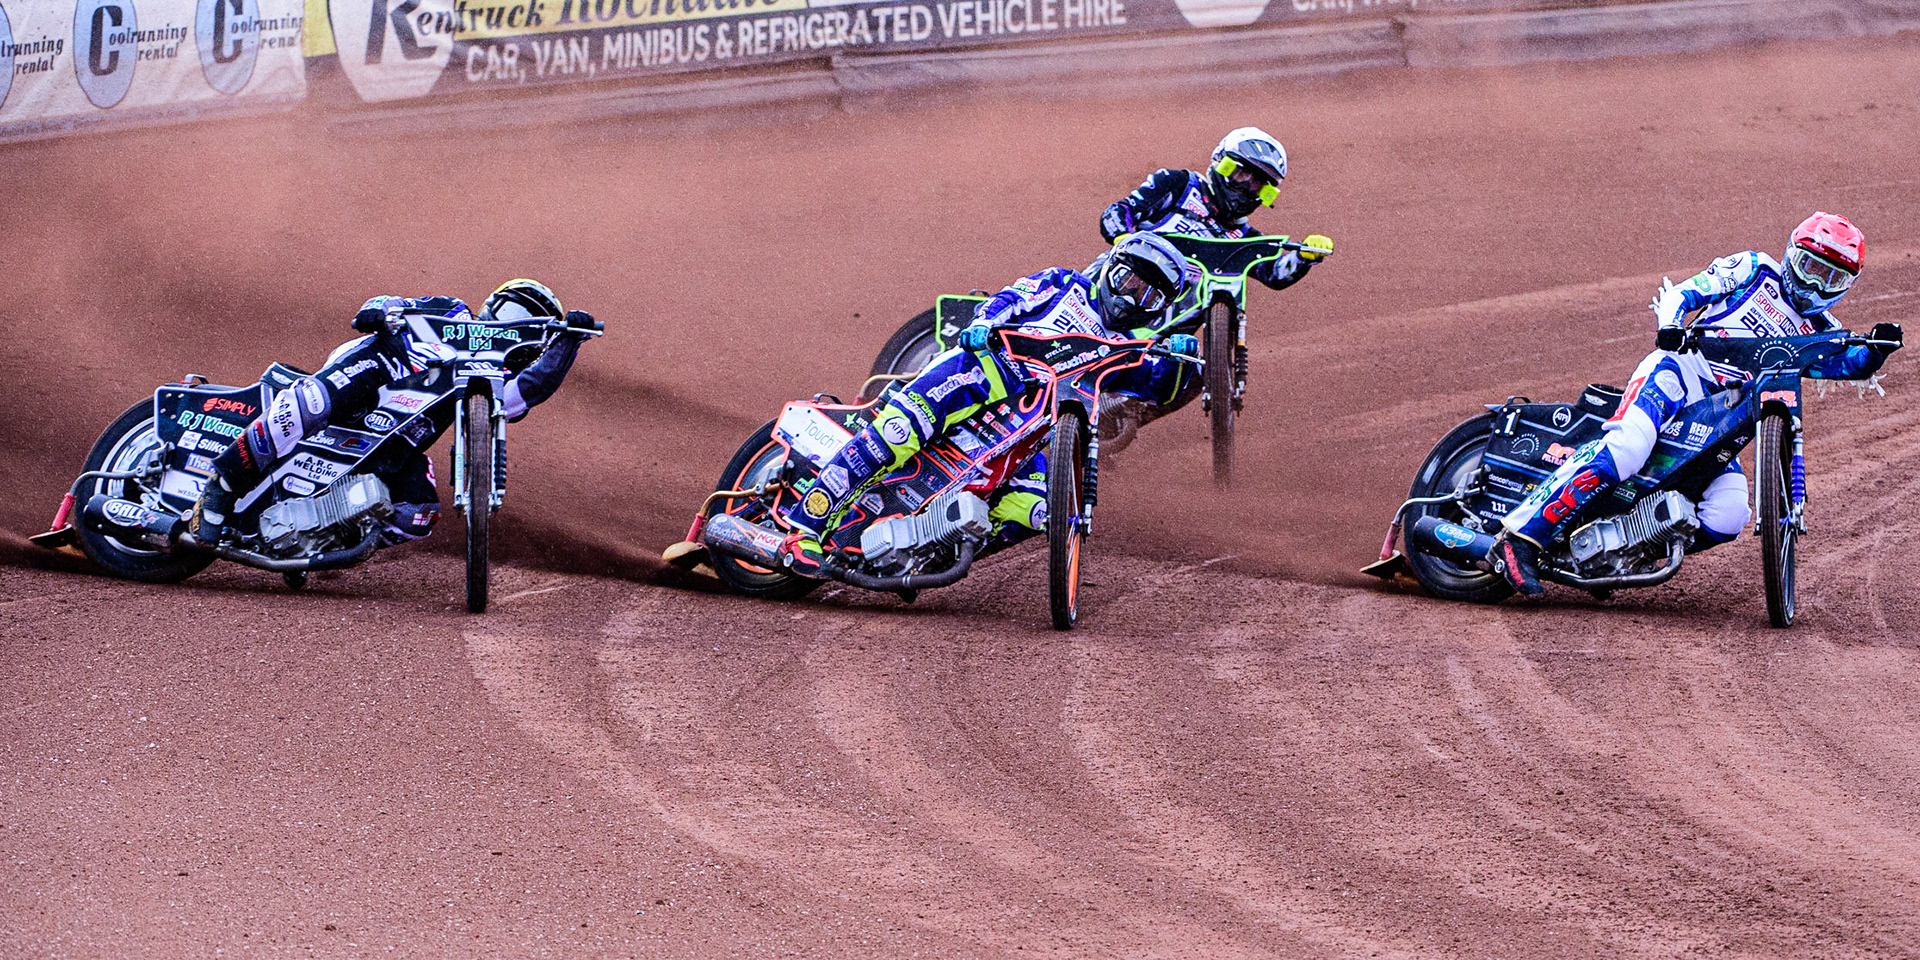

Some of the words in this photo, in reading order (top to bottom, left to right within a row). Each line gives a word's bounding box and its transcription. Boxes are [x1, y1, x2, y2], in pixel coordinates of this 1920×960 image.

[88, 5, 188, 76] Coolrunning
[465, 44, 528, 83] CAR,
[531, 37, 597, 77] VAN,
[602, 24, 710, 70] MINIBUS
[715, 21, 735, 59] &
[736, 4, 933, 58] REFRIGERATED
[936, 0, 1060, 39] VEHICLE
[1063, 0, 1128, 28] HIRE
[138, 42, 180, 61] rental
[15, 55, 55, 75] rental
[1066, 298, 1094, 328] SPORTS
[1756, 294, 1784, 323] SPORTS
[444, 325, 454, 340] R
[455, 325, 466, 341] J
[468, 324, 520, 341] Warren
[469, 336, 492, 351] Ltd
[214, 398, 256, 417] SIMPLY
[177, 410, 194, 428] R
[190, 413, 205, 430] J
[1504, 411, 1516, 434] 1
[293, 458, 339, 479] WELDING
[305, 456, 334, 470] A.R.C
[307, 471, 321, 481] Ltd
[757, 533, 781, 547] NGK
